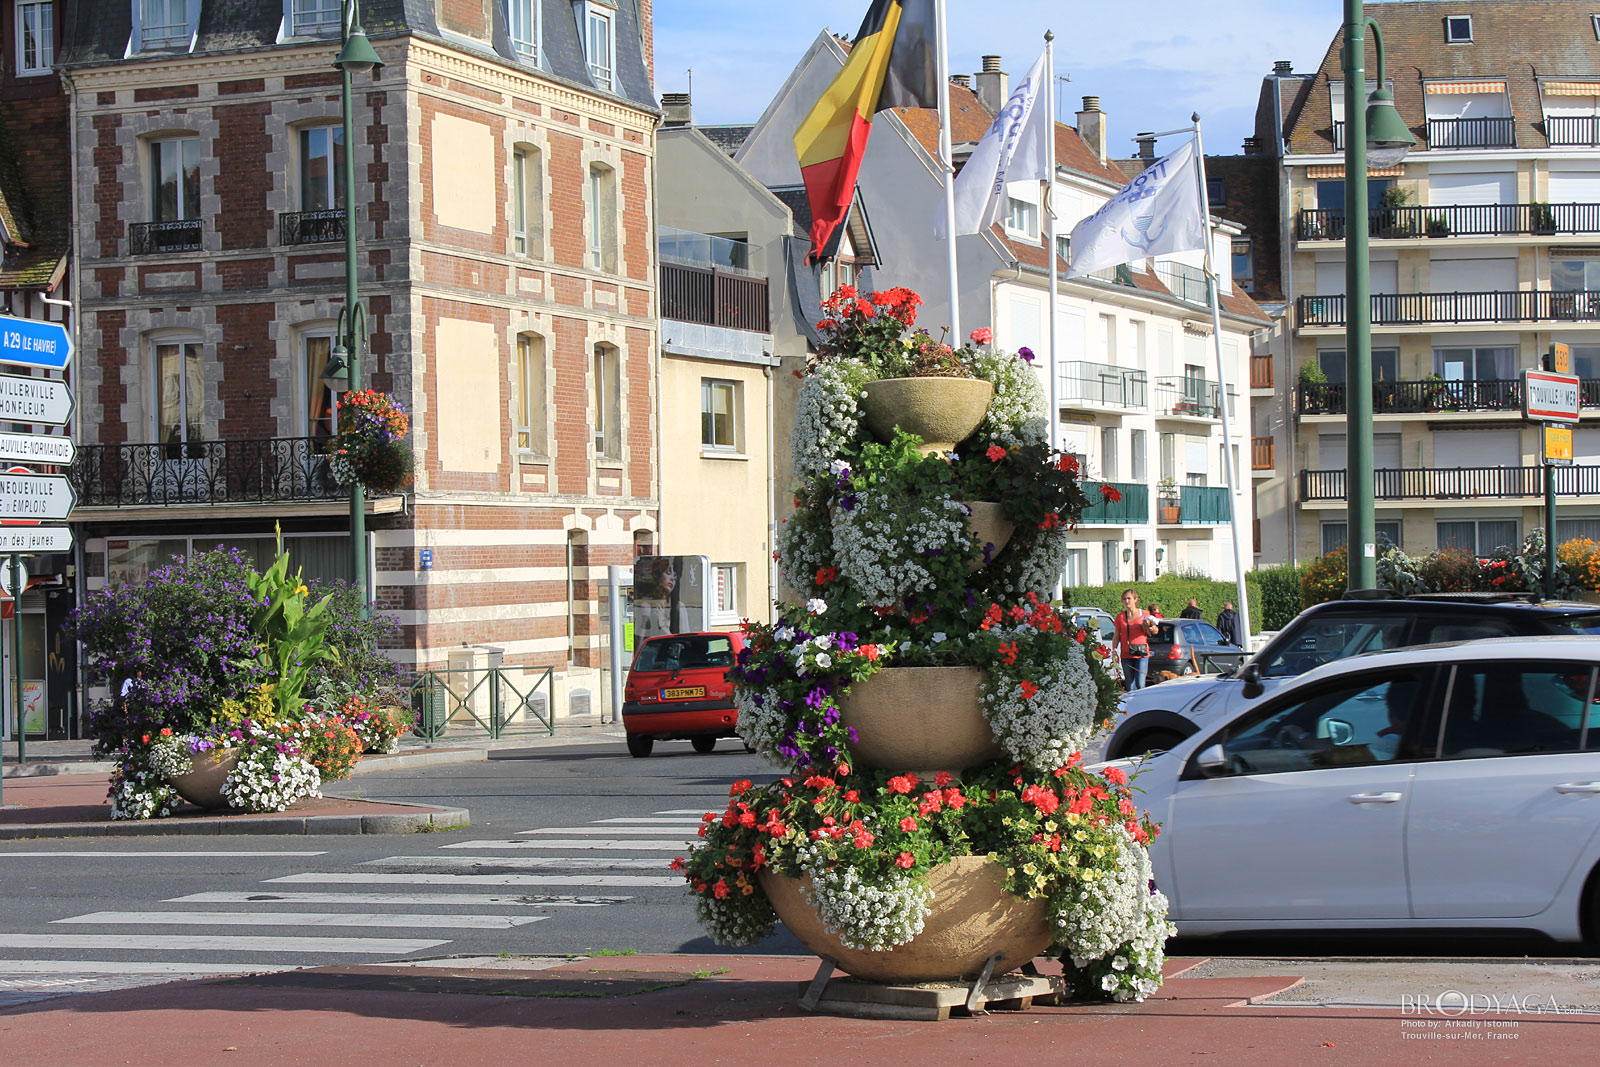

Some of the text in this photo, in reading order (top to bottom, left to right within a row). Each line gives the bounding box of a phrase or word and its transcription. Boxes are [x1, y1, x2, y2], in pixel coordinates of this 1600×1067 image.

[33, 338, 57, 355] HAVRE)
[1530, 386, 1558, 404] TROUVILLE
[1565, 390, 1576, 406] MER
[12, 533, 25, 546] des
[28, 533, 54, 549] jeunes
